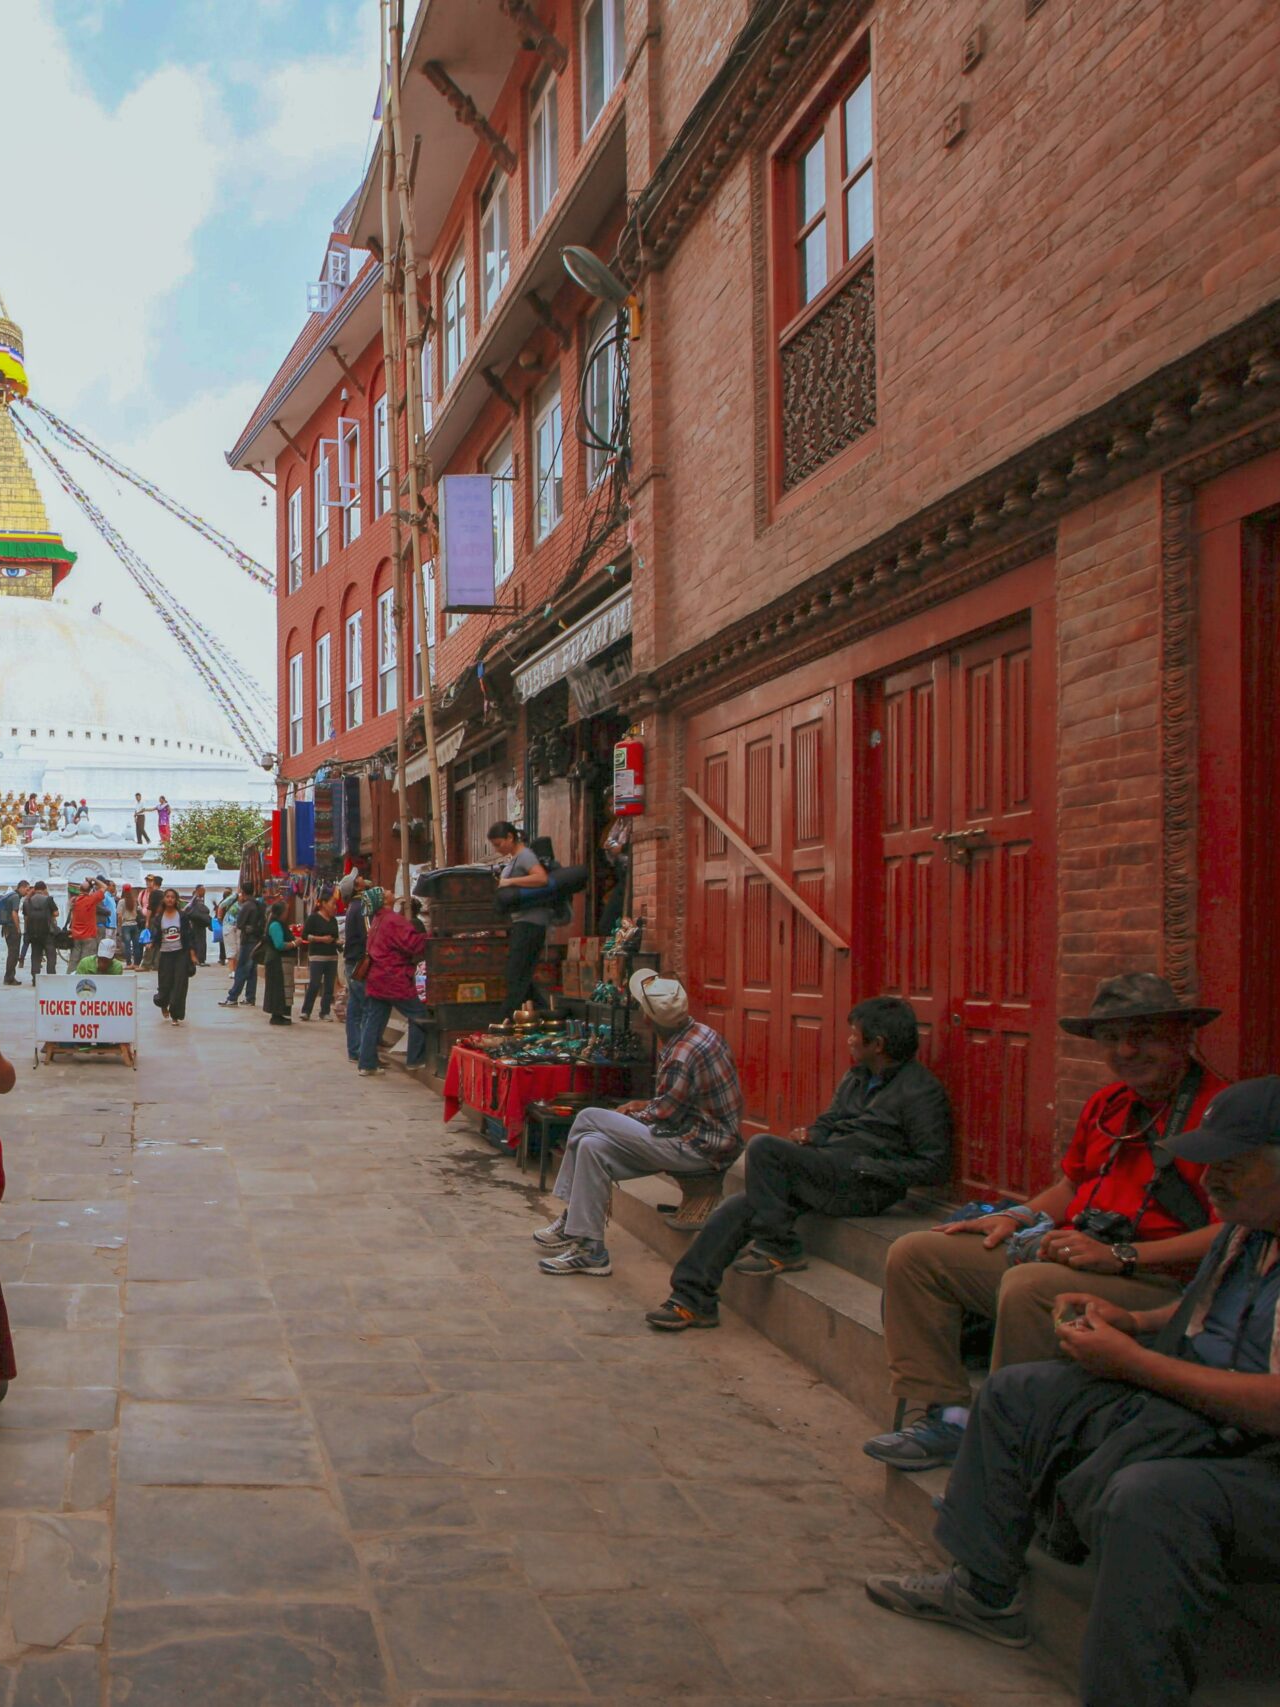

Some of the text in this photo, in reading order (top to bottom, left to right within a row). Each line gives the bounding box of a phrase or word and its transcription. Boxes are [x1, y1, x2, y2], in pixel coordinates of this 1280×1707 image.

[519, 654, 557, 698] TIBET
[561, 597, 632, 672] FURNITU
[39, 1000, 133, 1016] TICKET CHECKING
[73, 1024, 99, 1039] POST
